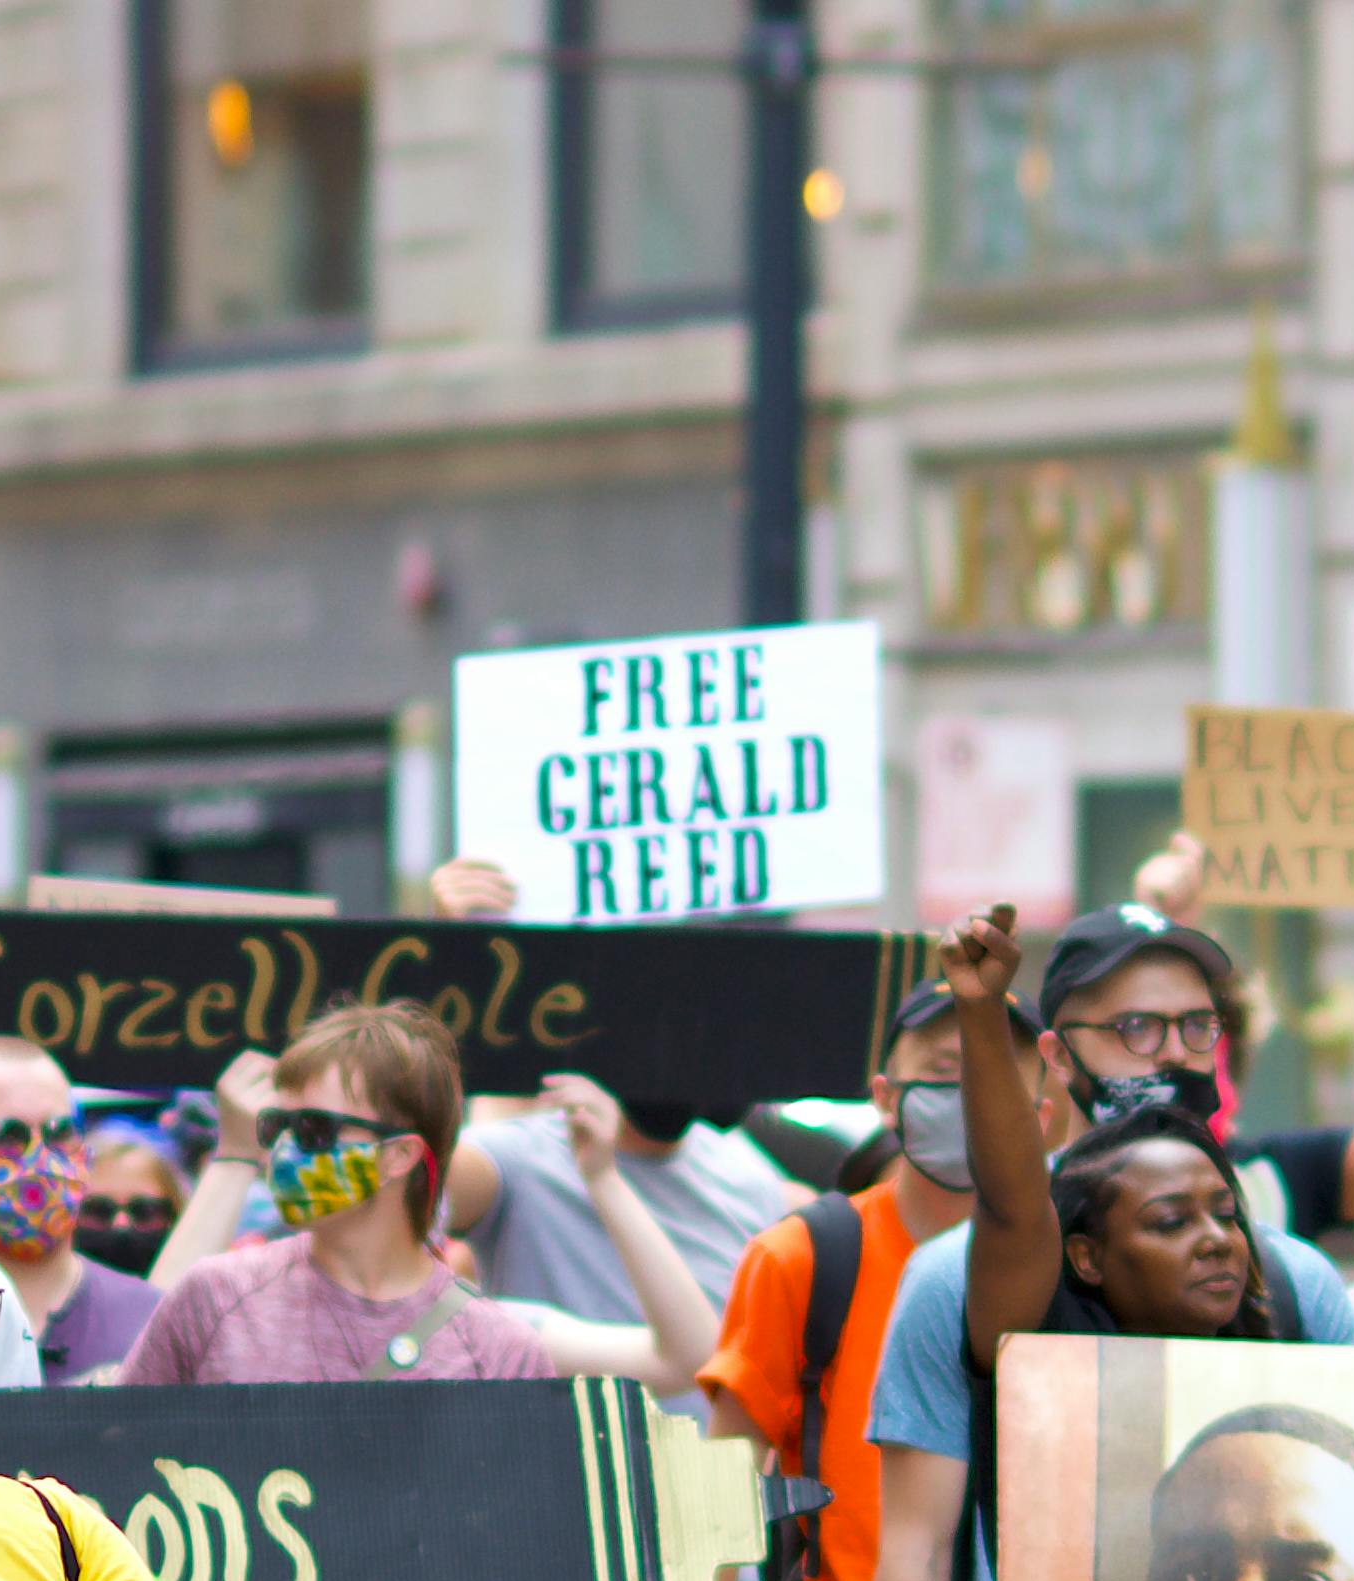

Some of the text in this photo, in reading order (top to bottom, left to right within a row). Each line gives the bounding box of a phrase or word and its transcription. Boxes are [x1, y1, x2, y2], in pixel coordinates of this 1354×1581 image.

[579, 643, 766, 737] FREE
[536, 734, 829, 835] GERALD
[571, 827, 770, 918] REED
